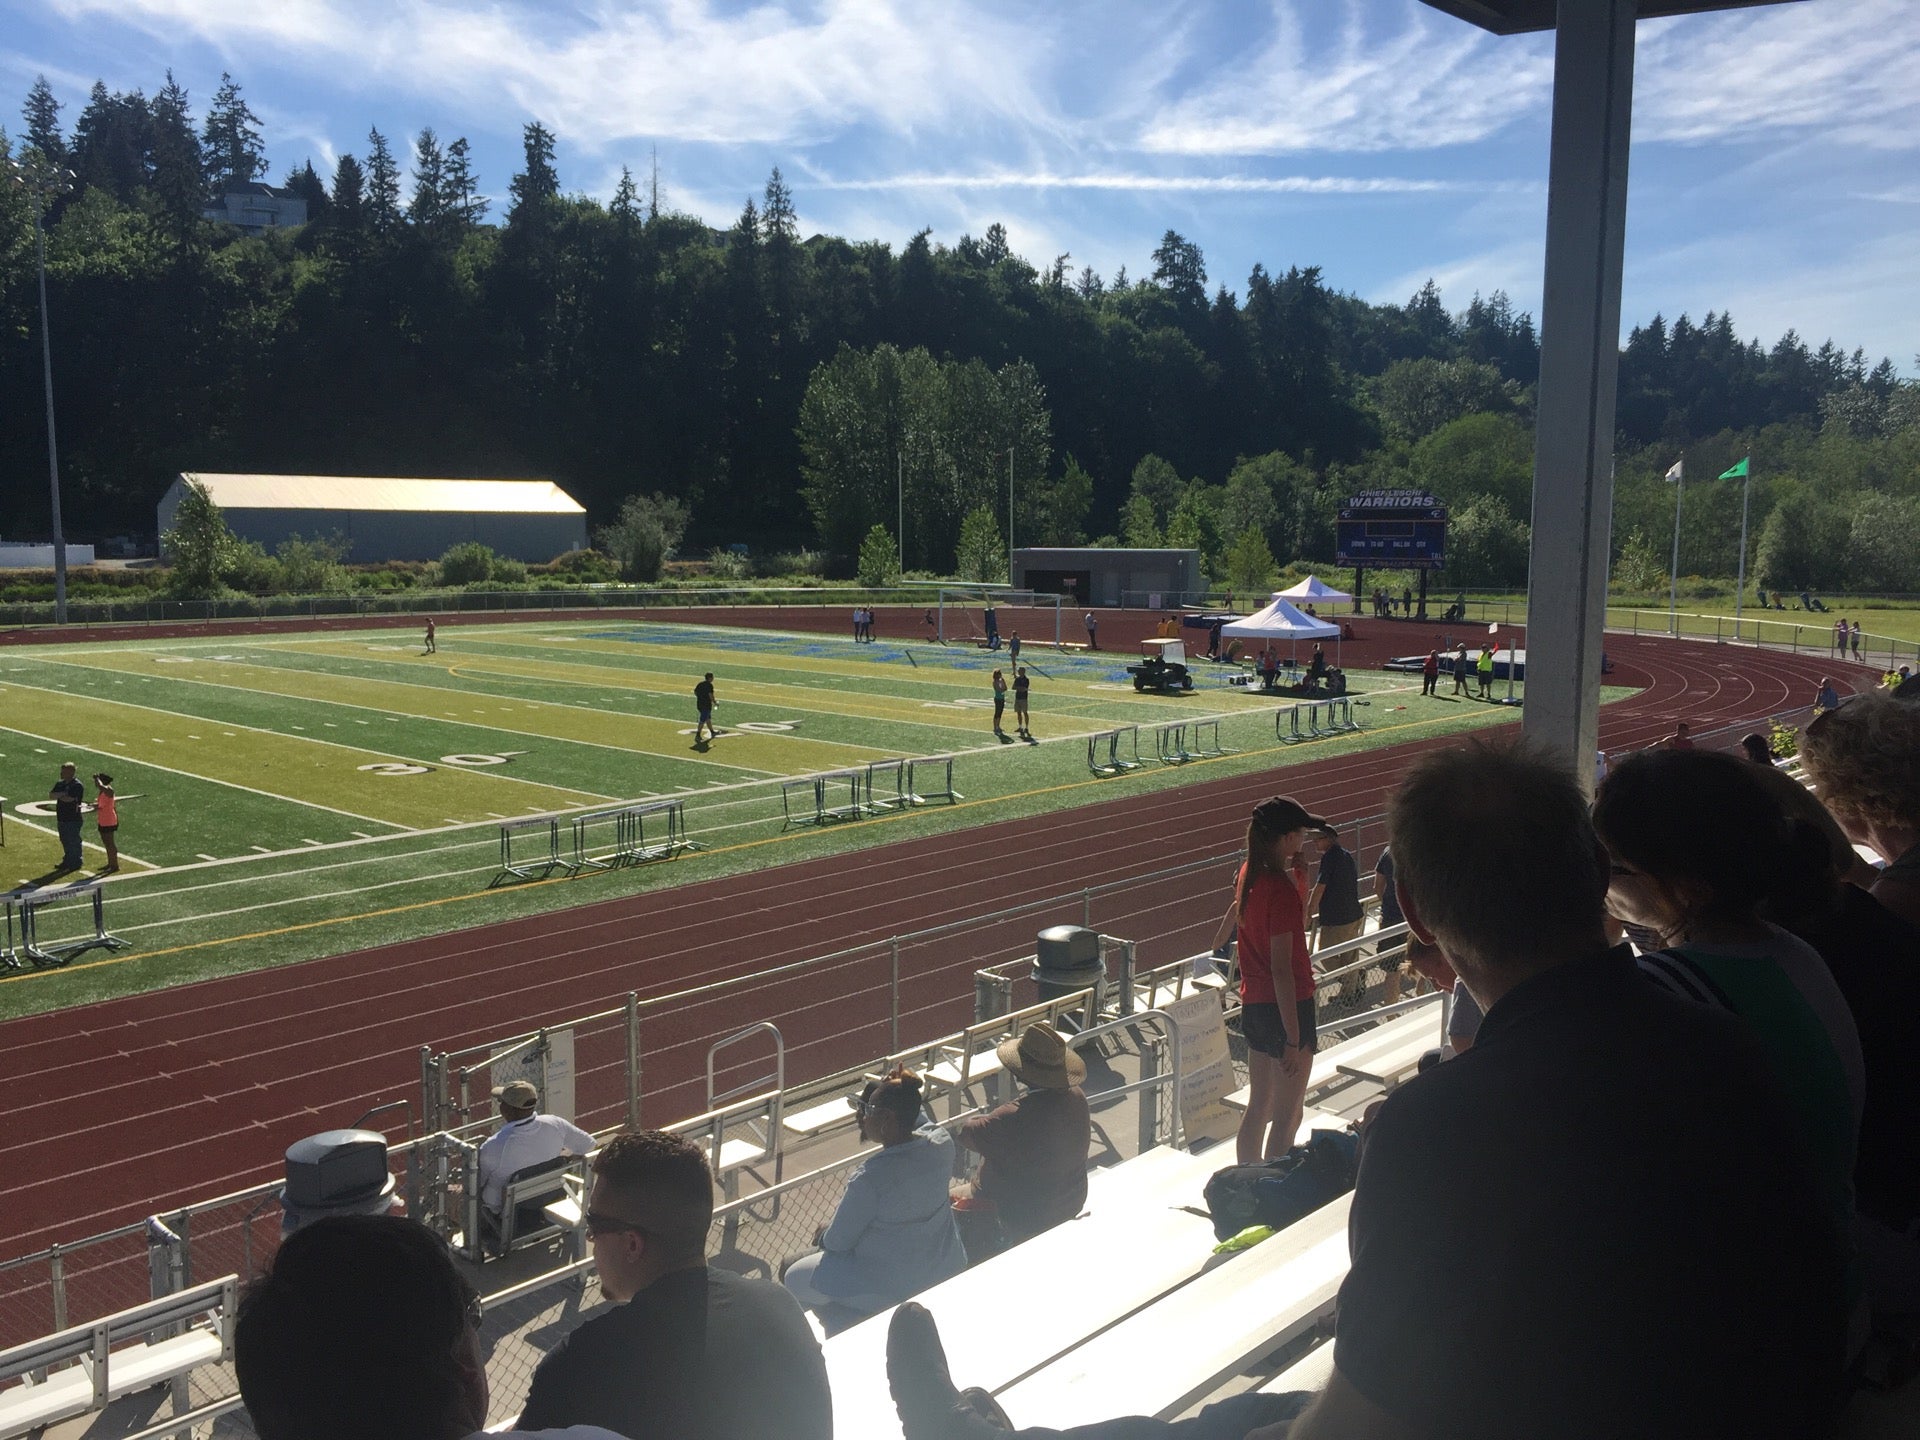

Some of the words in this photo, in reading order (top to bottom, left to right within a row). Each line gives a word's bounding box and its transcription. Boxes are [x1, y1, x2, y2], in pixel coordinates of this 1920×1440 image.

[1388, 489, 1422, 497] LESCHI
[1349, 496, 1434, 507] WARRIORS
[356, 753, 508, 776] 30
